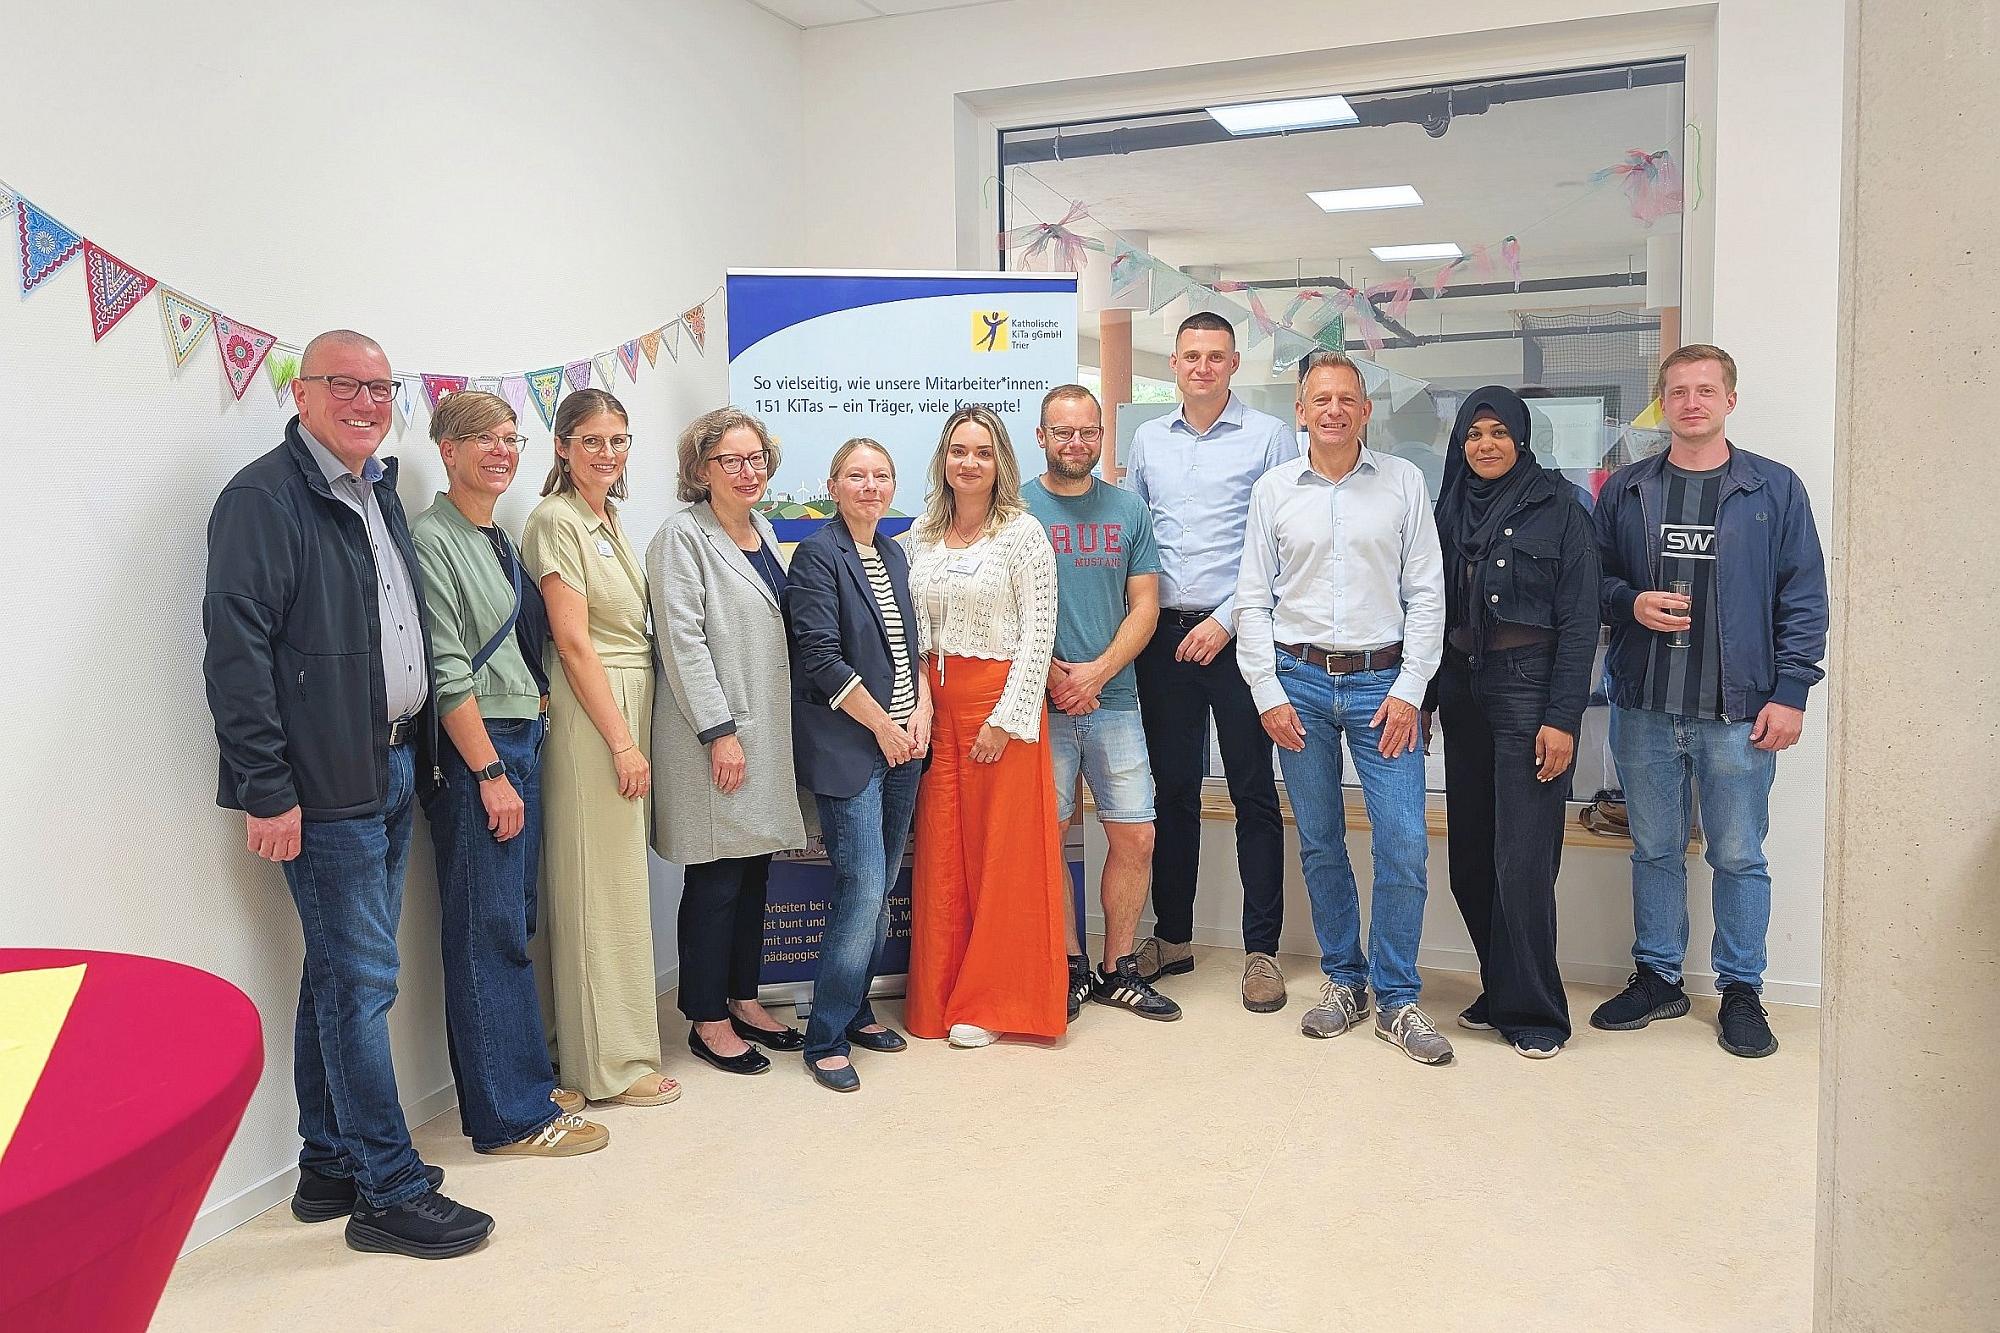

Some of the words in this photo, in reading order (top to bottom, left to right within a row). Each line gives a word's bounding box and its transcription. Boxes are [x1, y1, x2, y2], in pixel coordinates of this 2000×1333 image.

[1011, 319, 1059, 328] Katholische
[1011, 330, 1029, 338] KiTa
[1031, 330, 1062, 340] gGmbH
[1011, 341, 1030, 349] Trier
[753, 375, 772, 390] So
[776, 376, 842, 393] vielseitig,
[847, 376, 871, 390] wie
[875, 379, 921, 390] unsere
[755, 399, 780, 413] 151
[787, 398, 824, 413] KiTas
[843, 399, 863, 413] ein
[868, 399, 914, 416] Träger,
[918, 399, 949, 413] viele
[764, 902, 806, 913] Arbeiten
[809, 900, 825, 911] bei
[763, 919, 776, 930] ist
[779, 918, 803, 929] bunt
[806, 916, 826, 927] und
[763, 935, 781, 946] mit
[784, 936, 803, 945] uns
[805, 931, 823, 943] auf
